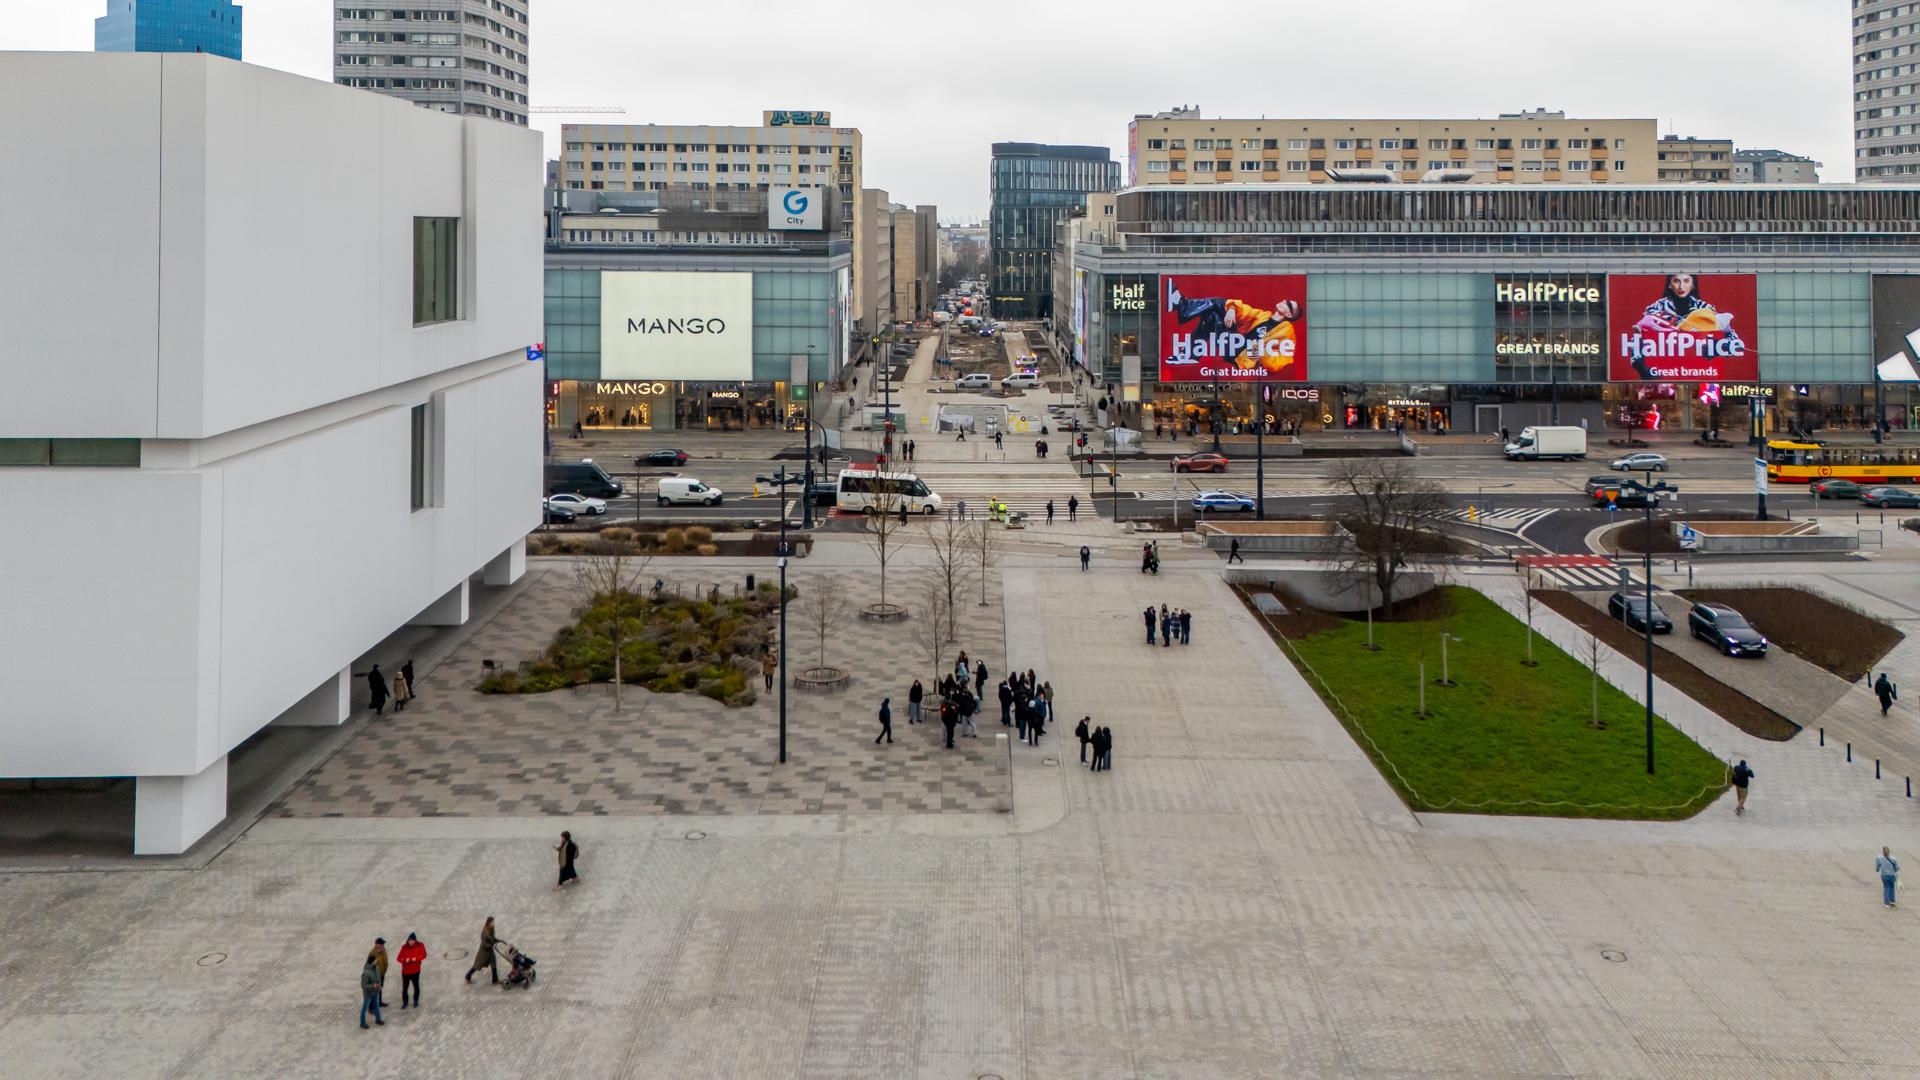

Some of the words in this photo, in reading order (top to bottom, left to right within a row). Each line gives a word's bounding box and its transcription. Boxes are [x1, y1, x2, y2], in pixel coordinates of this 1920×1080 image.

[786, 216, 805, 225] City
[1113, 284, 1145, 298] Half
[1496, 283, 1600, 302] HalfPrice
[1113, 298, 1146, 310] Price
[627, 318, 726, 334] MANGO
[1172, 332, 1295, 357] HalfPrice
[1496, 343, 1542, 354] GREAT
[1544, 343, 1600, 354] BRANDS
[1621, 332, 1745, 357] HalfPrice
[1231, 366, 1268, 377] brands
[1649, 366, 1679, 377] Great
[1681, 366, 1718, 377] brands
[596, 382, 665, 395] MANGO
[1282, 389, 1319, 399] IQOS
